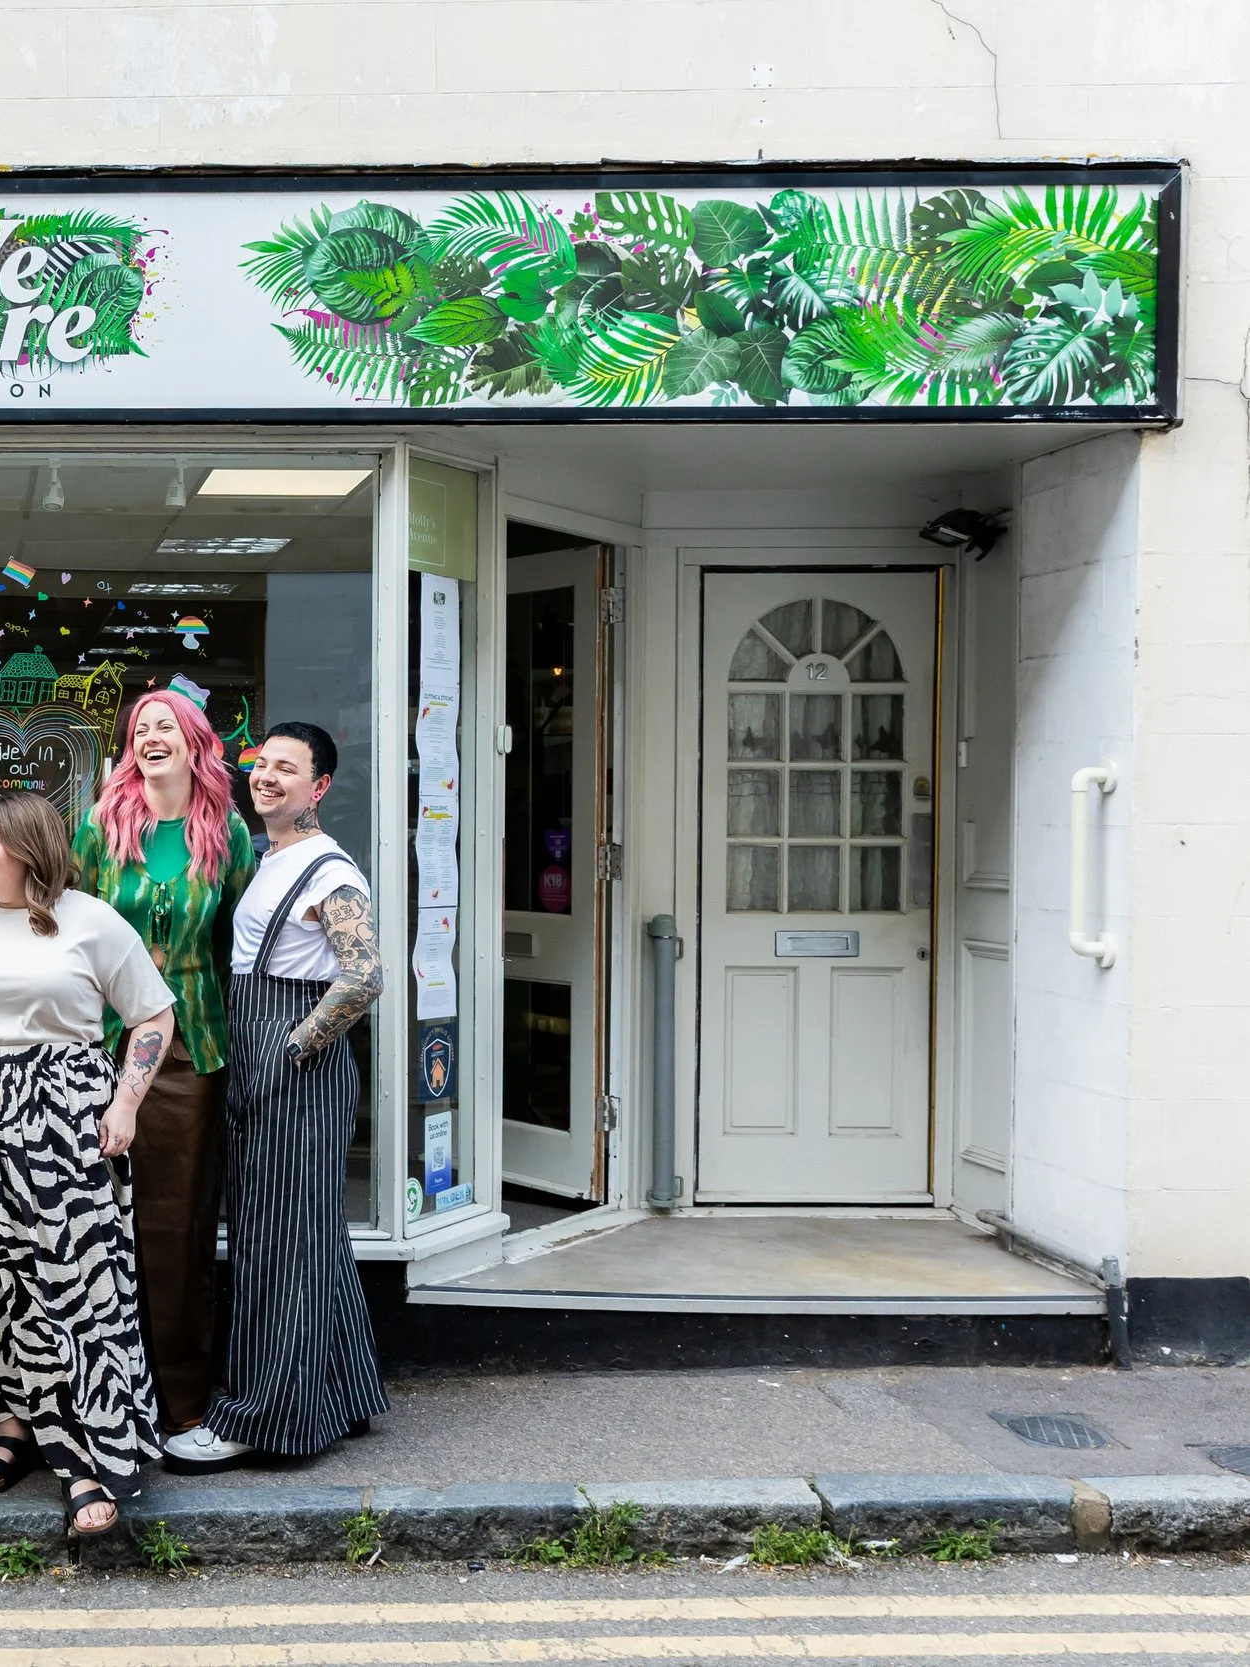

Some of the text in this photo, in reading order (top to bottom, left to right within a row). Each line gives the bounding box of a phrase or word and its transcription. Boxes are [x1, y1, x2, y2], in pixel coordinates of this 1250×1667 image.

[806, 662, 828, 681] 12
[9, 762, 40, 775] our
[543, 873, 563, 888] K18
[428, 1122, 440, 1132] Book
